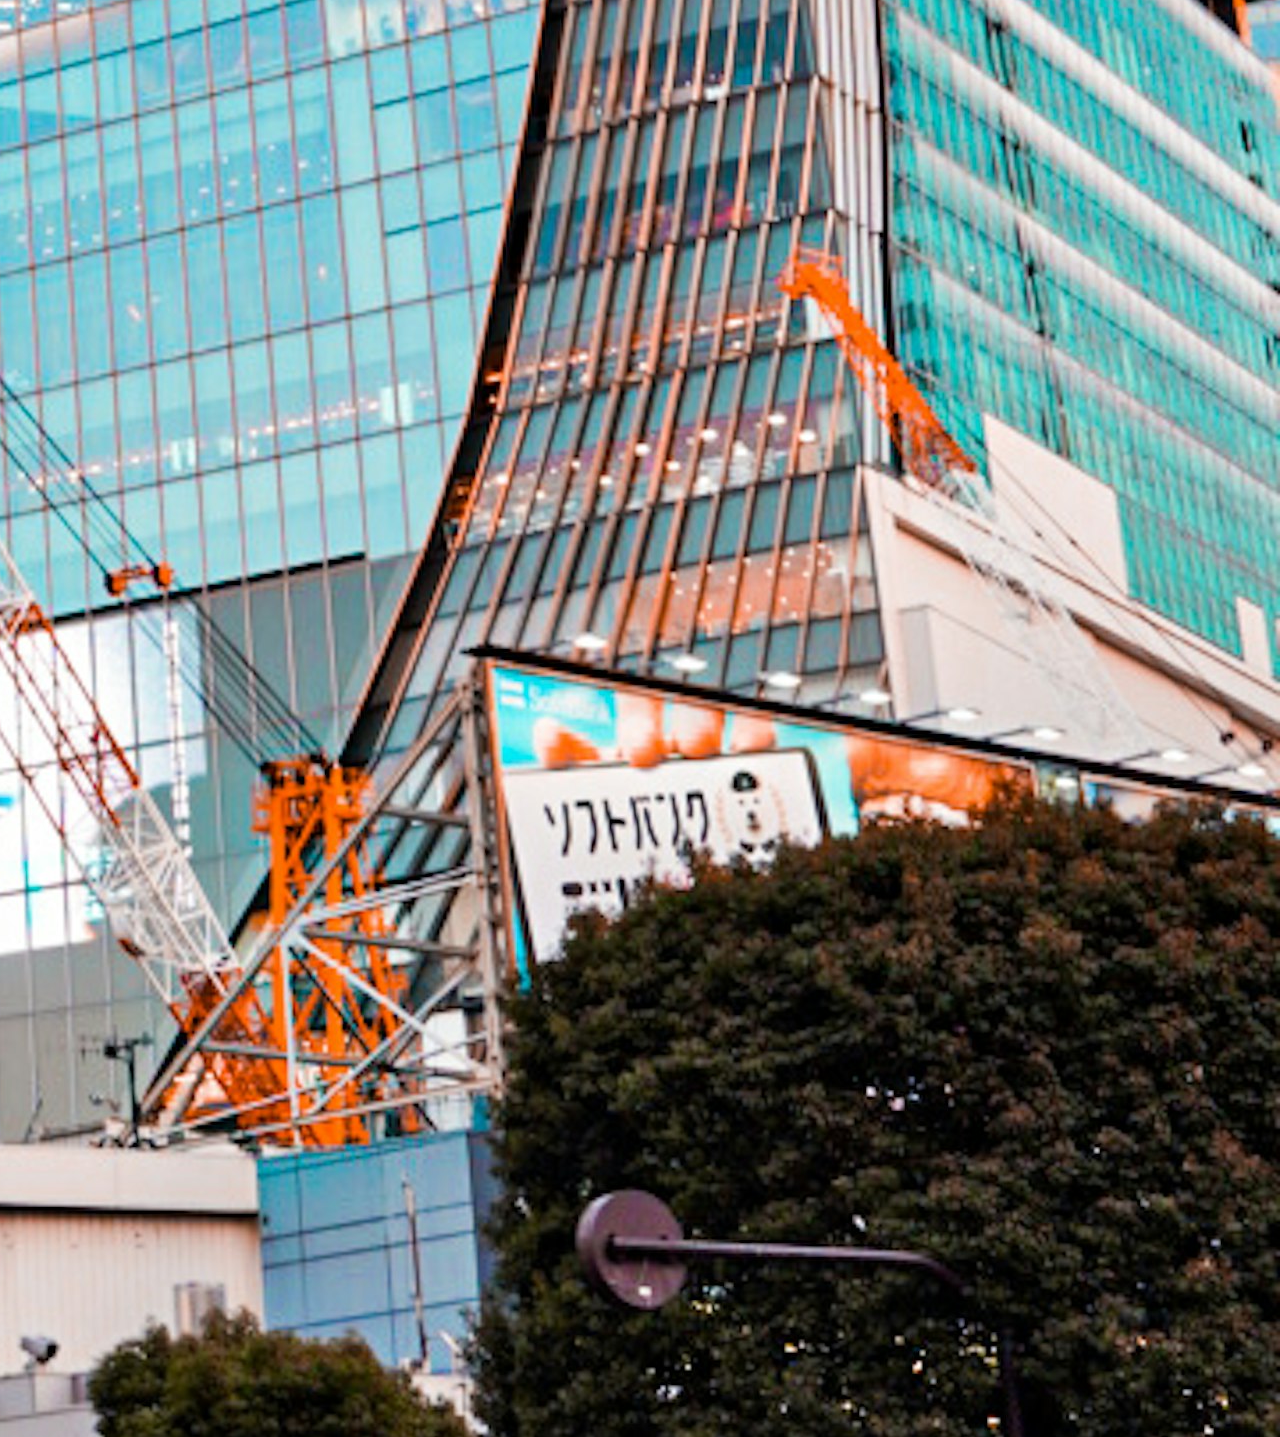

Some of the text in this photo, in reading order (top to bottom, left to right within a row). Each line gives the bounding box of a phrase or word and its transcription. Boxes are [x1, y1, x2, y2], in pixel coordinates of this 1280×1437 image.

[543, 790, 710, 858] ソフトバンク
